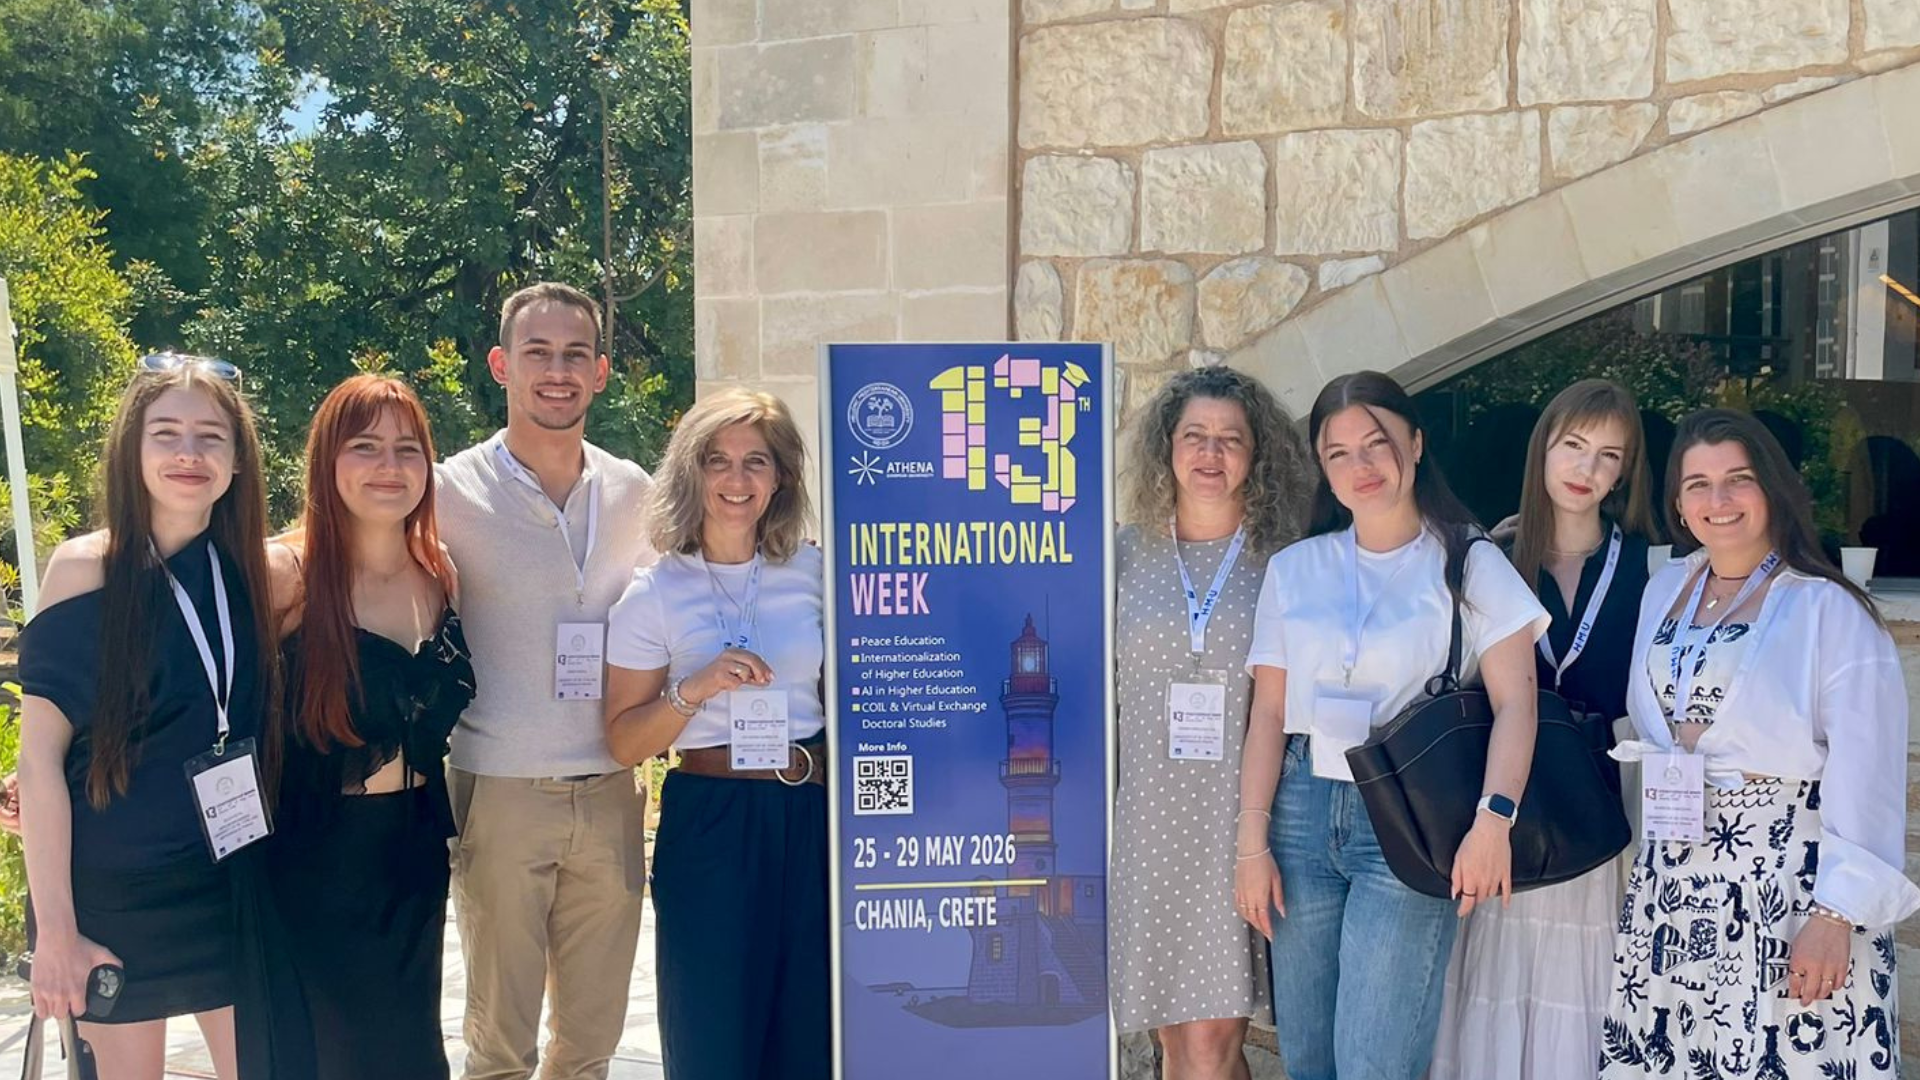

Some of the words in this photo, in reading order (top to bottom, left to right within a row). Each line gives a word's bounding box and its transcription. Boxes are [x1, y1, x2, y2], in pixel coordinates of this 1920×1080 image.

[886, 461, 935, 474] ATHENA
[850, 520, 1073, 566] INTERNATIONAL
[850, 572, 930, 616] WEEK
[861, 636, 892, 647] Peace
[894, 635, 945, 646] Education
[861, 652, 961, 663] Internationalization
[861, 669, 873, 680] of
[875, 669, 910, 682] Higher
[912, 668, 964, 679] Education
[861, 686, 873, 696] AI
[875, 685, 885, 695] in
[888, 685, 923, 698] Higher
[925, 684, 977, 695] Education
[861, 702, 888, 713] COIL
[889, 702, 900, 712] &
[901, 701, 936, 712] Virtual
[938, 701, 988, 713] Exchange
[862, 718, 907, 729] Doctoral
[909, 717, 947, 728] Studies
[858, 743, 885, 752] More
[886, 742, 907, 751] Info
[853, 837, 877, 868] 25
[896, 836, 919, 867] 29
[925, 834, 965, 867] MAY
[970, 833, 1016, 865] 2026
[854, 898, 933, 933] CHANIA,
[938, 896, 997, 928] CRETE
